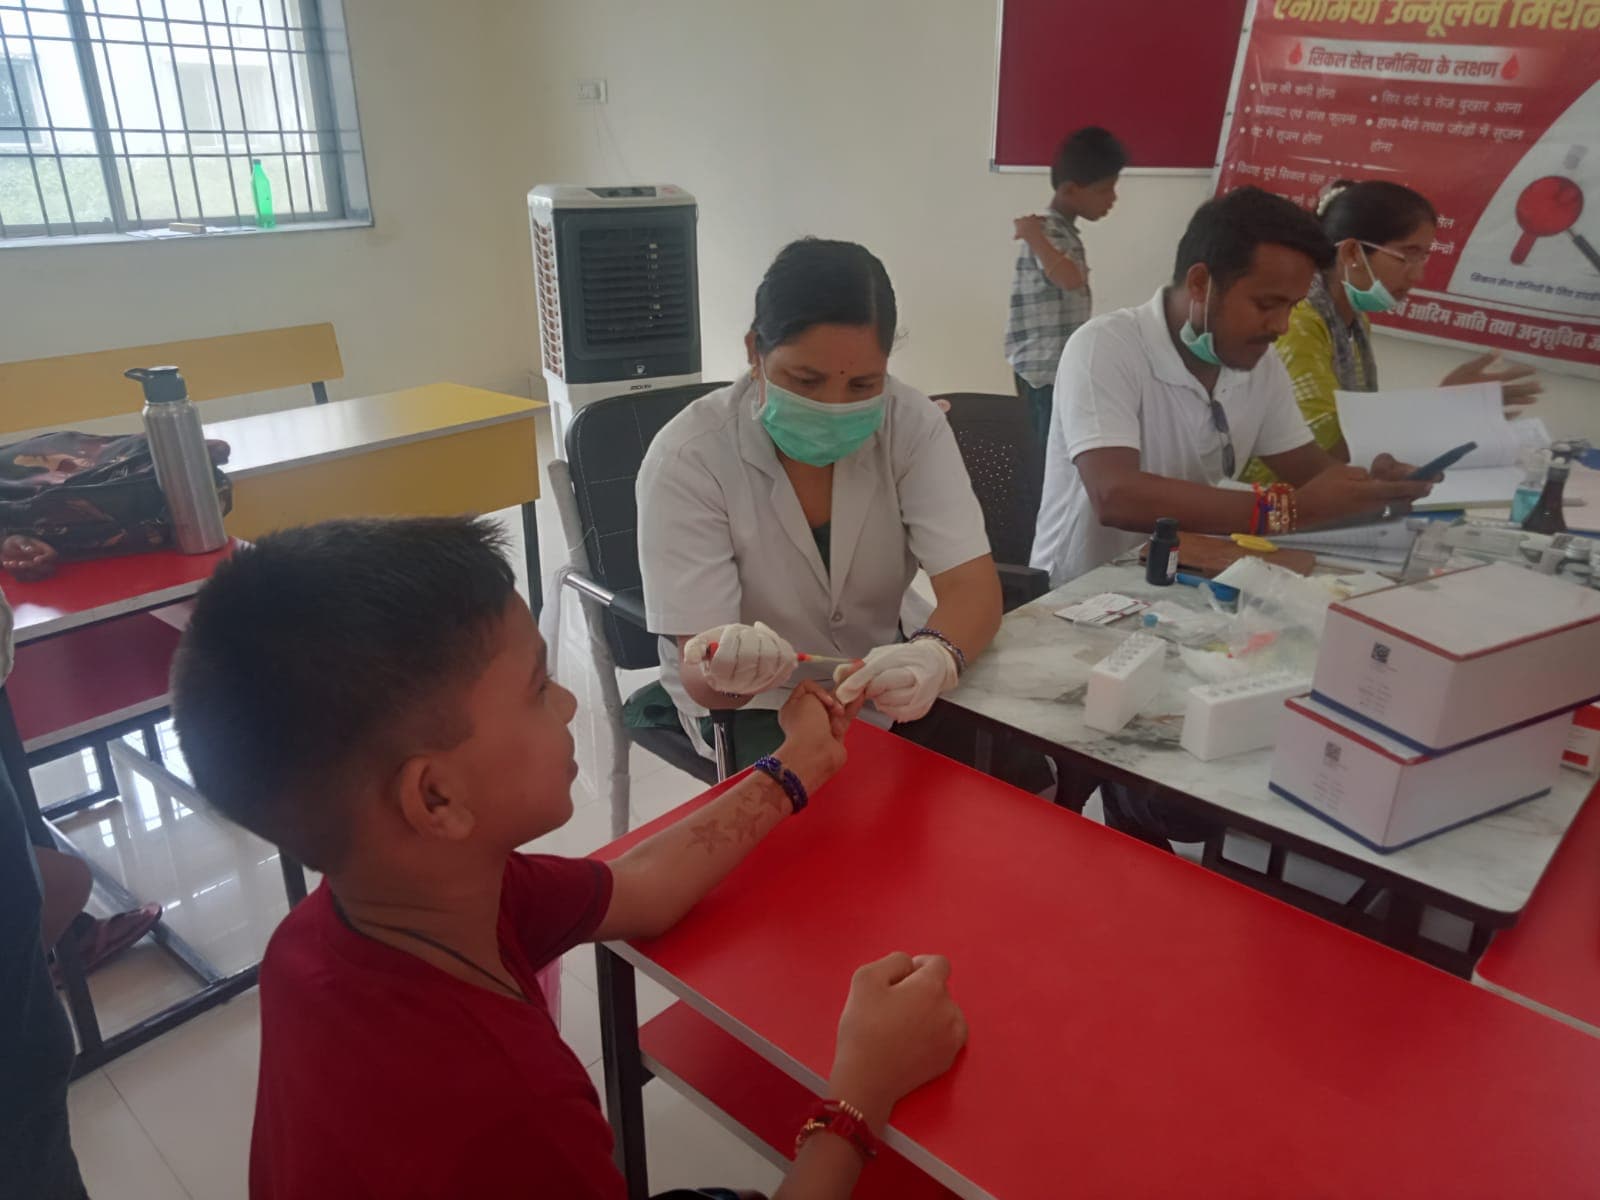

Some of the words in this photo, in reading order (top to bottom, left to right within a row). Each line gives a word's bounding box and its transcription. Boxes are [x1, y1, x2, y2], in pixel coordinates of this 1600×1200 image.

[1308, 47, 1348, 67] सिकल
[1350, 50, 1374, 71] सेल
[1435, 54, 1453, 75] के
[1453, 60, 1500, 78] लक्षण
[1408, 303, 1453, 327] आदिम
[1453, 311, 1489, 333] जाति
[1489, 318, 1517, 337] तथा
